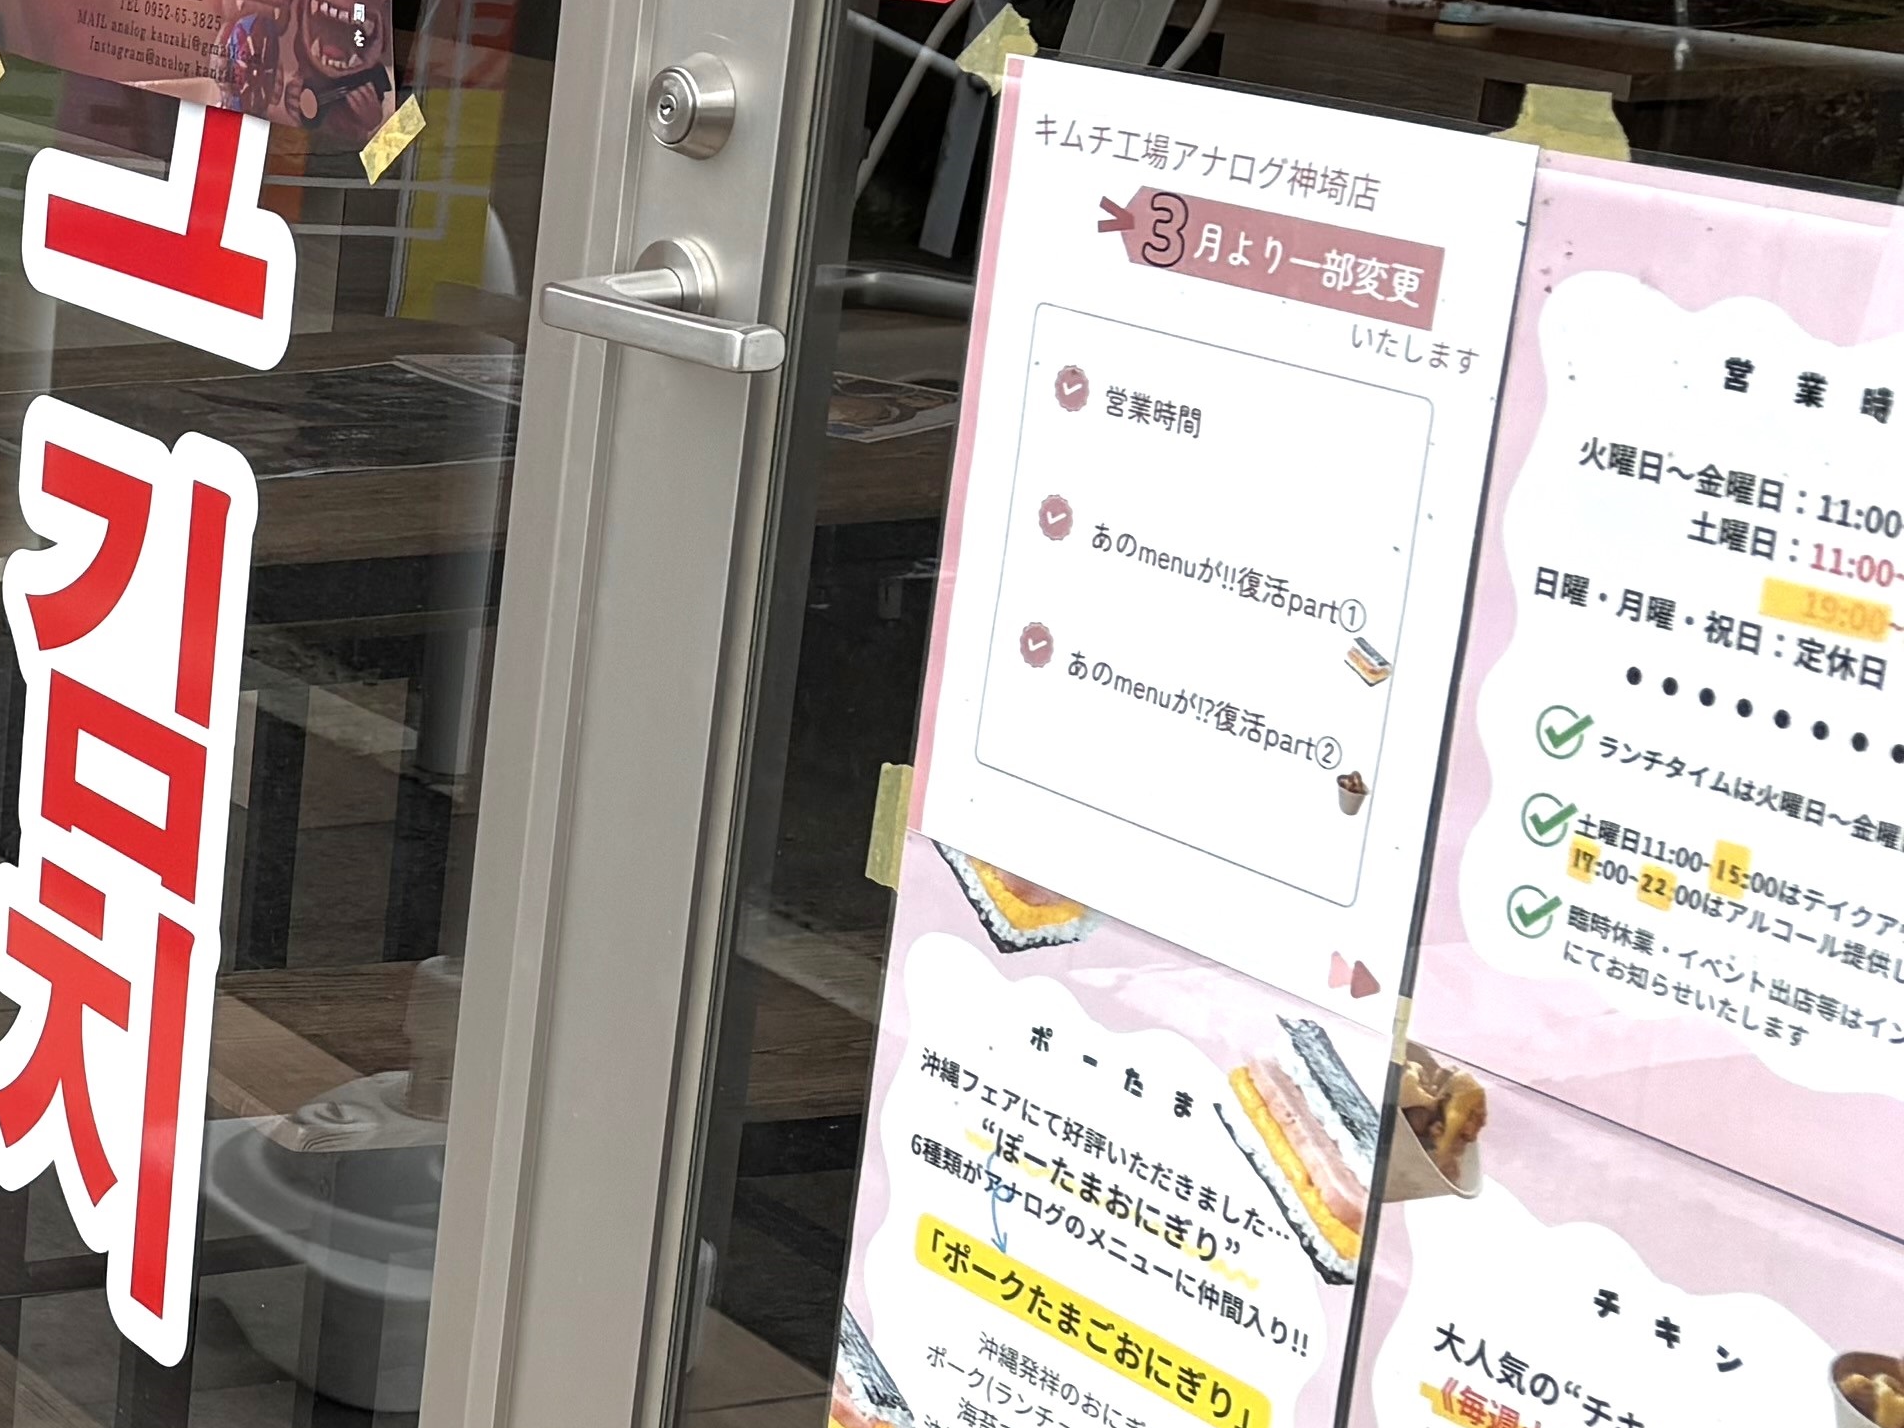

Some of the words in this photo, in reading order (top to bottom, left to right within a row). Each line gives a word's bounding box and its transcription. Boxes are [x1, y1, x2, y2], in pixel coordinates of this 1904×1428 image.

[1140, 190, 1427, 310] 3月より一部変更
[1350, 323, 1481, 376] いたします
[1106, 385, 1203, 439] 営業時間
[1563, 939, 1811, 1047] にてお知らせいたします
[1593, 1288, 1743, 1373] チキン
